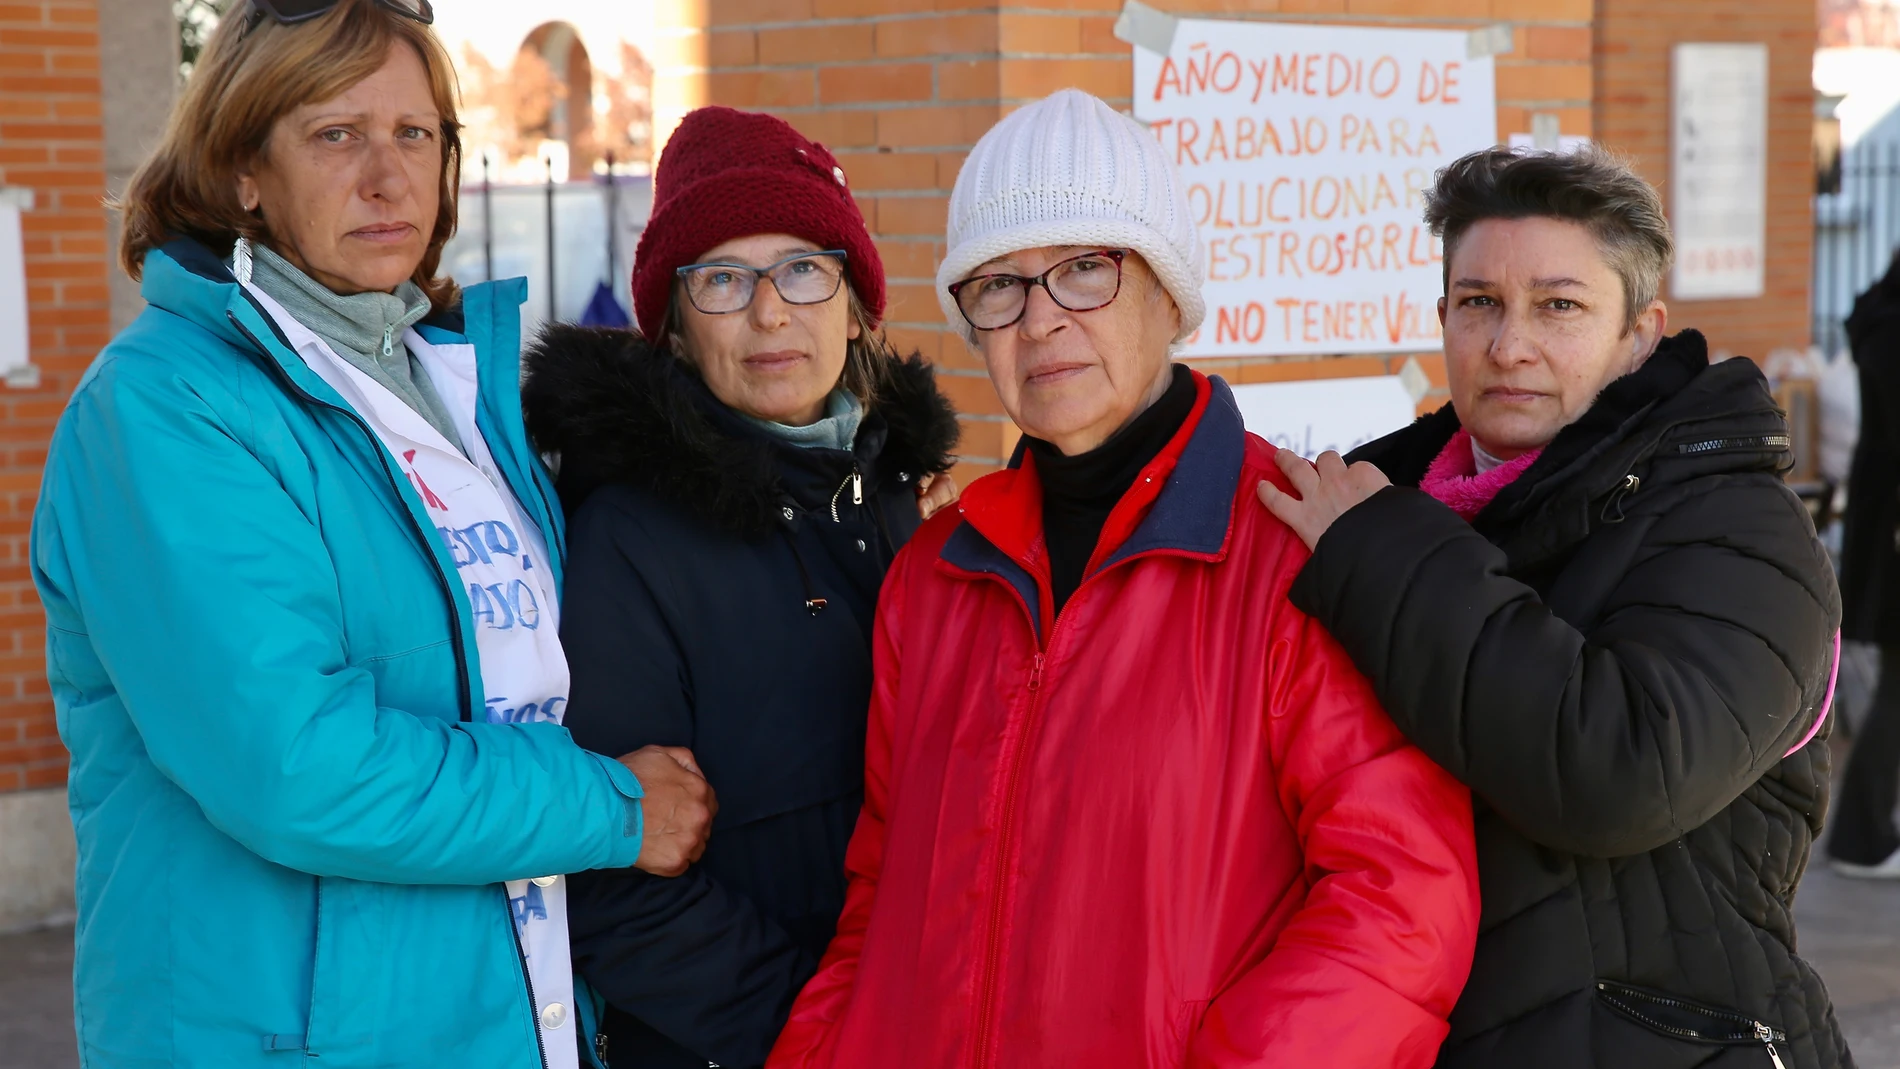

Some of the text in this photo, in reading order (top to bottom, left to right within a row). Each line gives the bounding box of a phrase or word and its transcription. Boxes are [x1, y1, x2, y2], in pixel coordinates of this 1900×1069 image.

[1154, 42, 1242, 101] AÑO
[1272, 52, 1400, 100] MEDIO
[1417, 61, 1461, 104] DE
[1151, 114, 1442, 166] TRABAJO PARA
[1187, 167, 1429, 230] OLUCIONAR
[1216, 301, 1267, 344] NO
[1273, 296, 1379, 344] TENER
[469, 578, 540, 632] AJO
